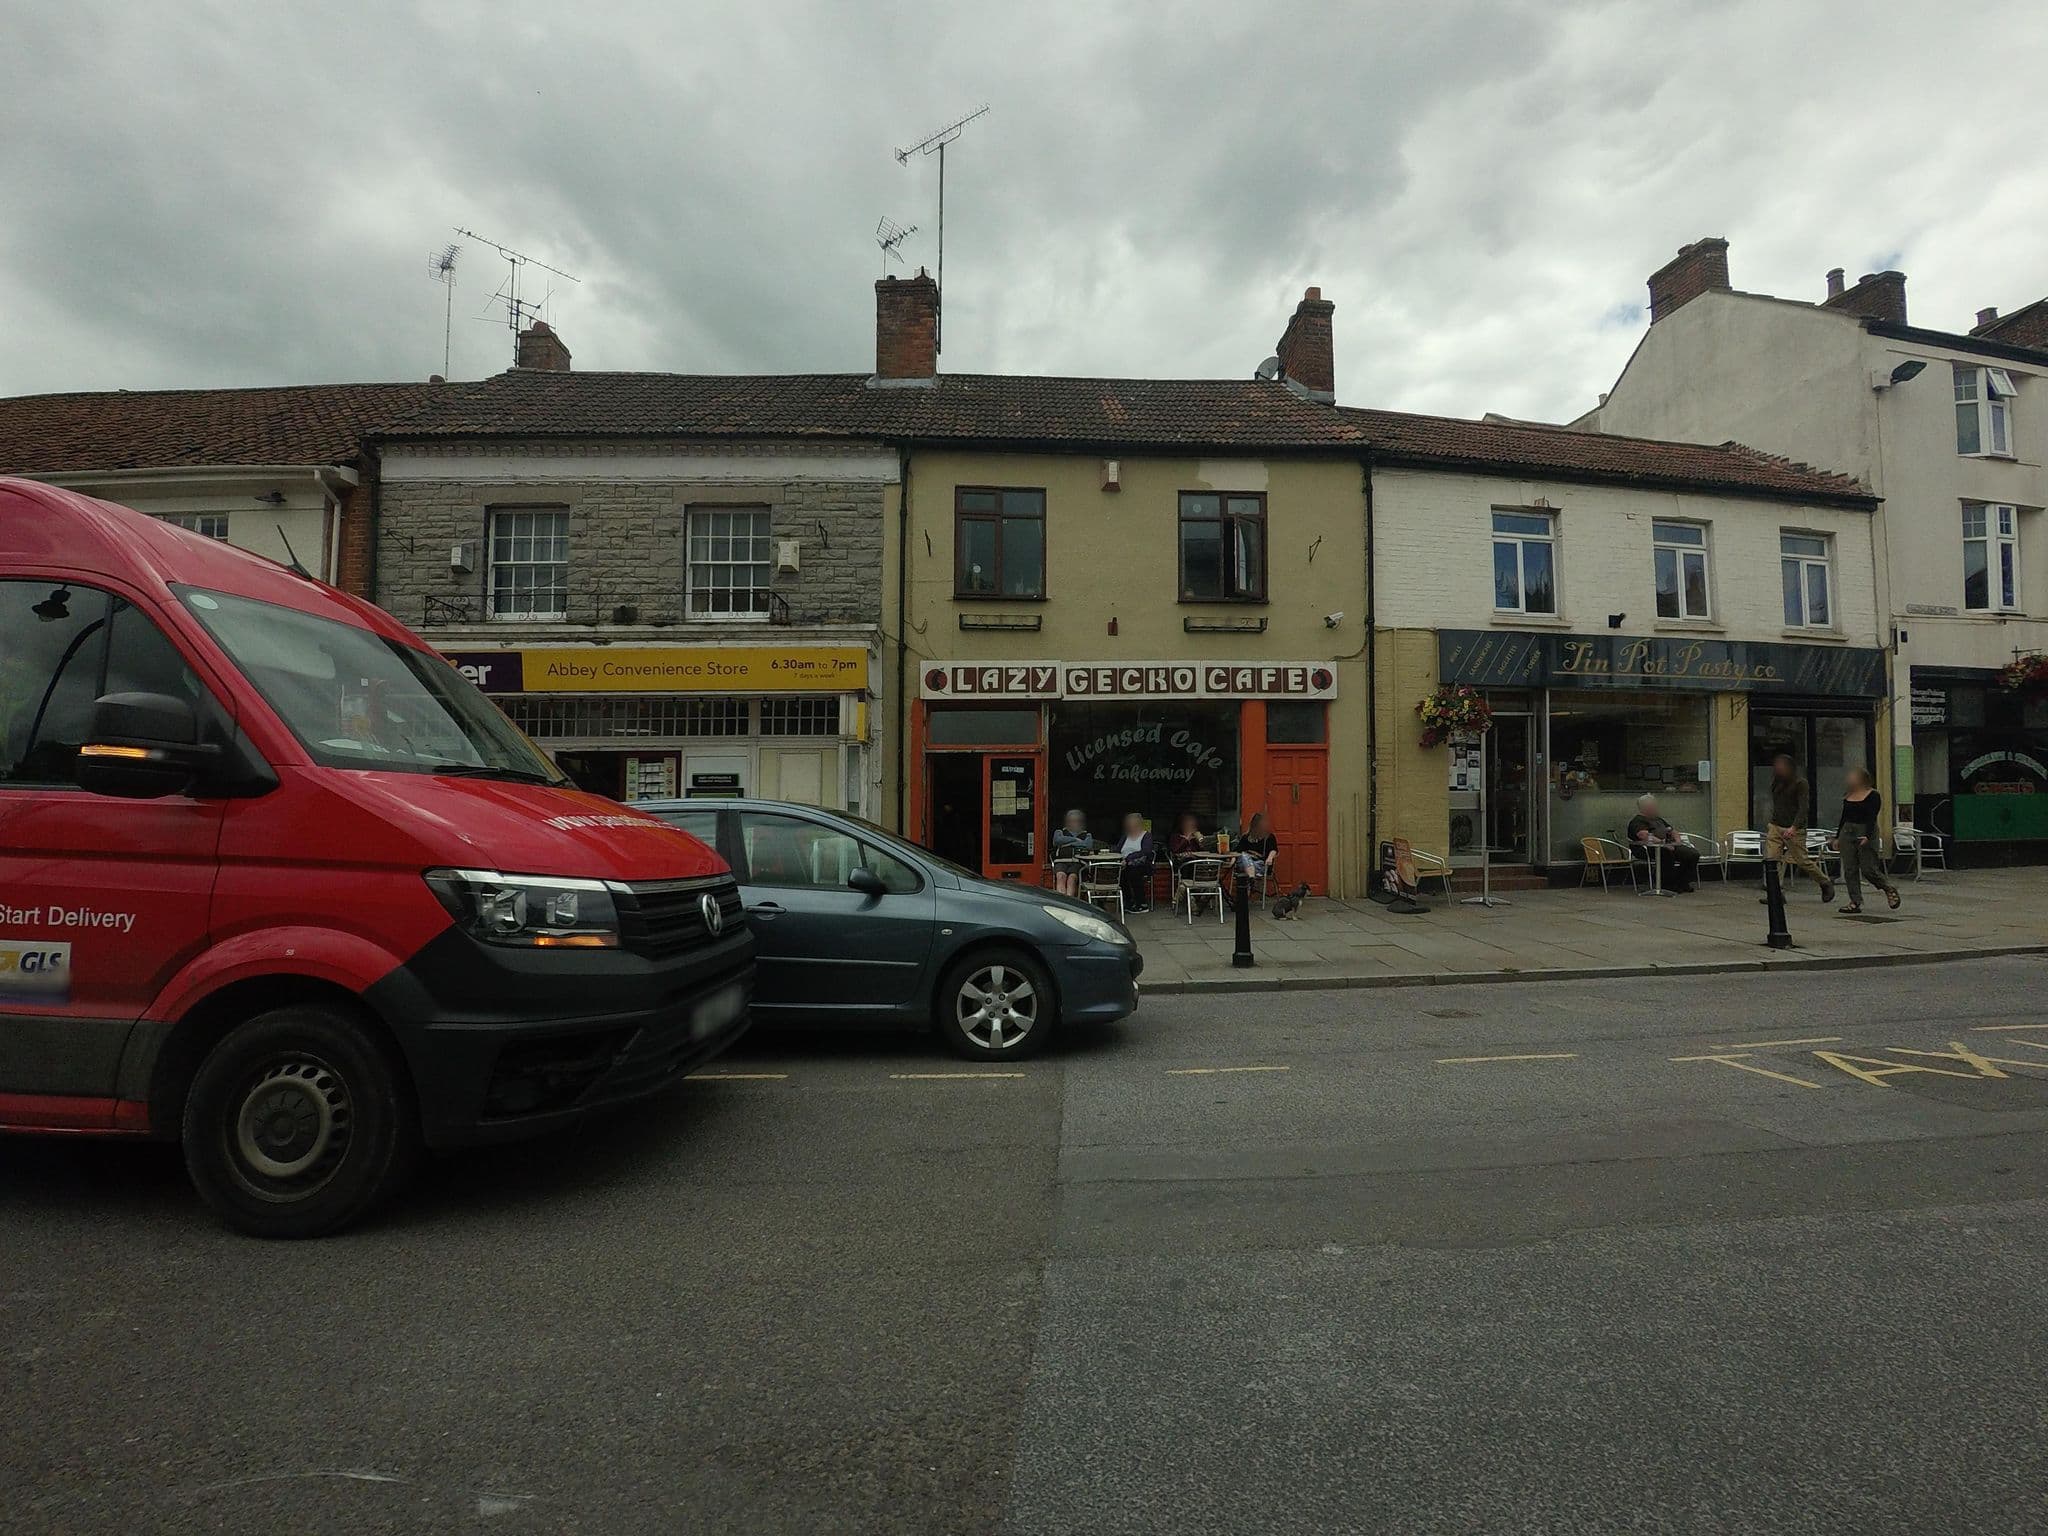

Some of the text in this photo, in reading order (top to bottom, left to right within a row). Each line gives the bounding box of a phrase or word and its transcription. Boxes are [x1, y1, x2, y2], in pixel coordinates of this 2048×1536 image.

[547, 661, 749, 680] Abbey Convenience Store
[771, 659, 857, 671] 6.30am to 7pm
[1562, 640, 1609, 673] Tin
[1618, 637, 1667, 674] Pot
[1674, 640, 1748, 690] Pasty
[956, 667, 1307, 693] LAZY GECKO CAFE
[1065, 722, 1224, 772] Licensed Cafe
[1093, 763, 1196, 784] & Takeaway
[47, 906, 136, 933] Delivery
[1668, 1038, 2048, 1089] TAX
